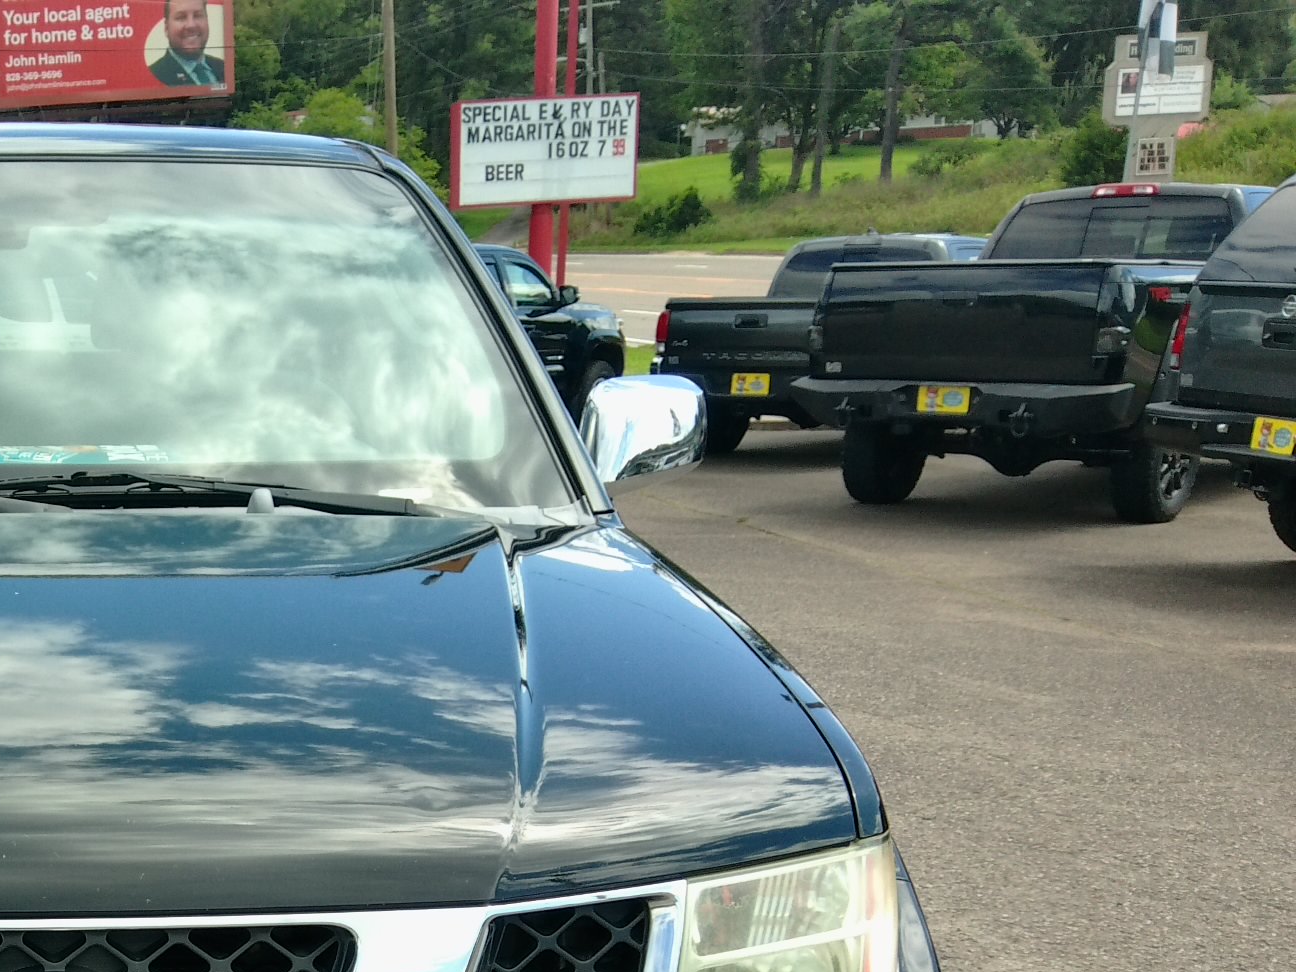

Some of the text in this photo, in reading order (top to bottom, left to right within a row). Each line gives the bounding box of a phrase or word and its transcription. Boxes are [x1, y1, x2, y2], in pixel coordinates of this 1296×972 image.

[2, 3, 130, 26] Your local agent
[3, 24, 134, 46] for home & auto
[5, 51, 82, 68] John Hamlin
[462, 104, 531, 124] SPECIAL
[600, 99, 635, 118] DAY
[467, 118, 628, 144] MARGARITA ON THE
[598, 140, 606, 157] 7
[485, 163, 524, 182] BEER
